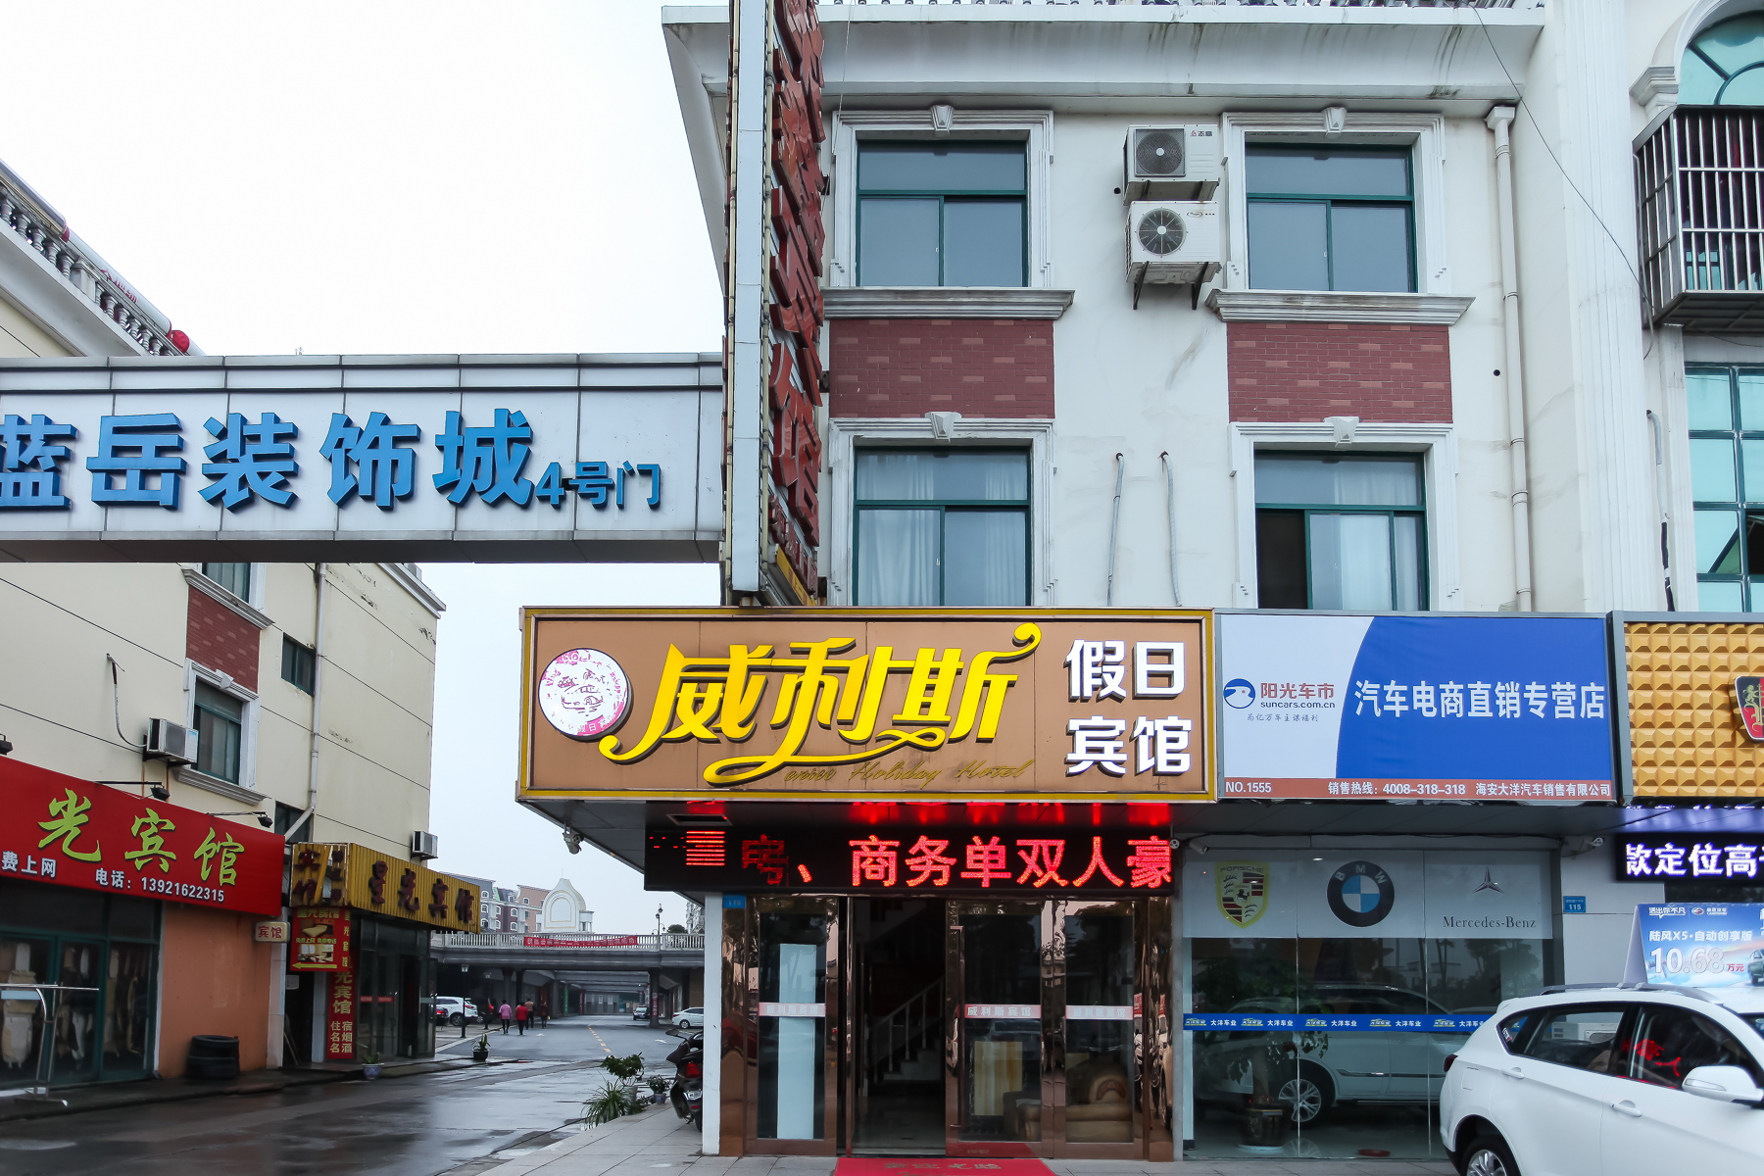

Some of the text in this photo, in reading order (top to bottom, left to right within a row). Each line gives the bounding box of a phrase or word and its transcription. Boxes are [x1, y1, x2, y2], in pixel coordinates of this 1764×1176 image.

[0, 408, 535, 513] 蓝岳装饰城
[1064, 638, 1187, 701] 假日
[1260, 682, 1335, 699] 阳光车市
[1354, 680, 1606, 721] 汽车电商直销专营店
[599, 622, 1042, 786] 威利斯
[1260, 701, 1336, 709] suncars.com.cn
[1064, 715, 1192, 777] 宾馆
[849, 760, 943, 790] Holiday
[955, 759, 1036, 779] Hotel
[1225, 781, 1273, 793] NO.1555
[1475, 782, 1612, 797] 海安大洋汽车销售有限公司
[1, 850, 57, 879] 费上网
[1220, 865, 1265, 873] PORSCHE
[1626, 841, 1764, 878] 款定位高
[1334, 864, 1388, 884] BMW
[258, 925, 283, 939] 宾馆
[1443, 915, 1537, 928] Mercedes-Benz
[1650, 947, 1746, 974] 10.68 万元
[967, 1006, 1033, 1017] 威利斯宾馆
